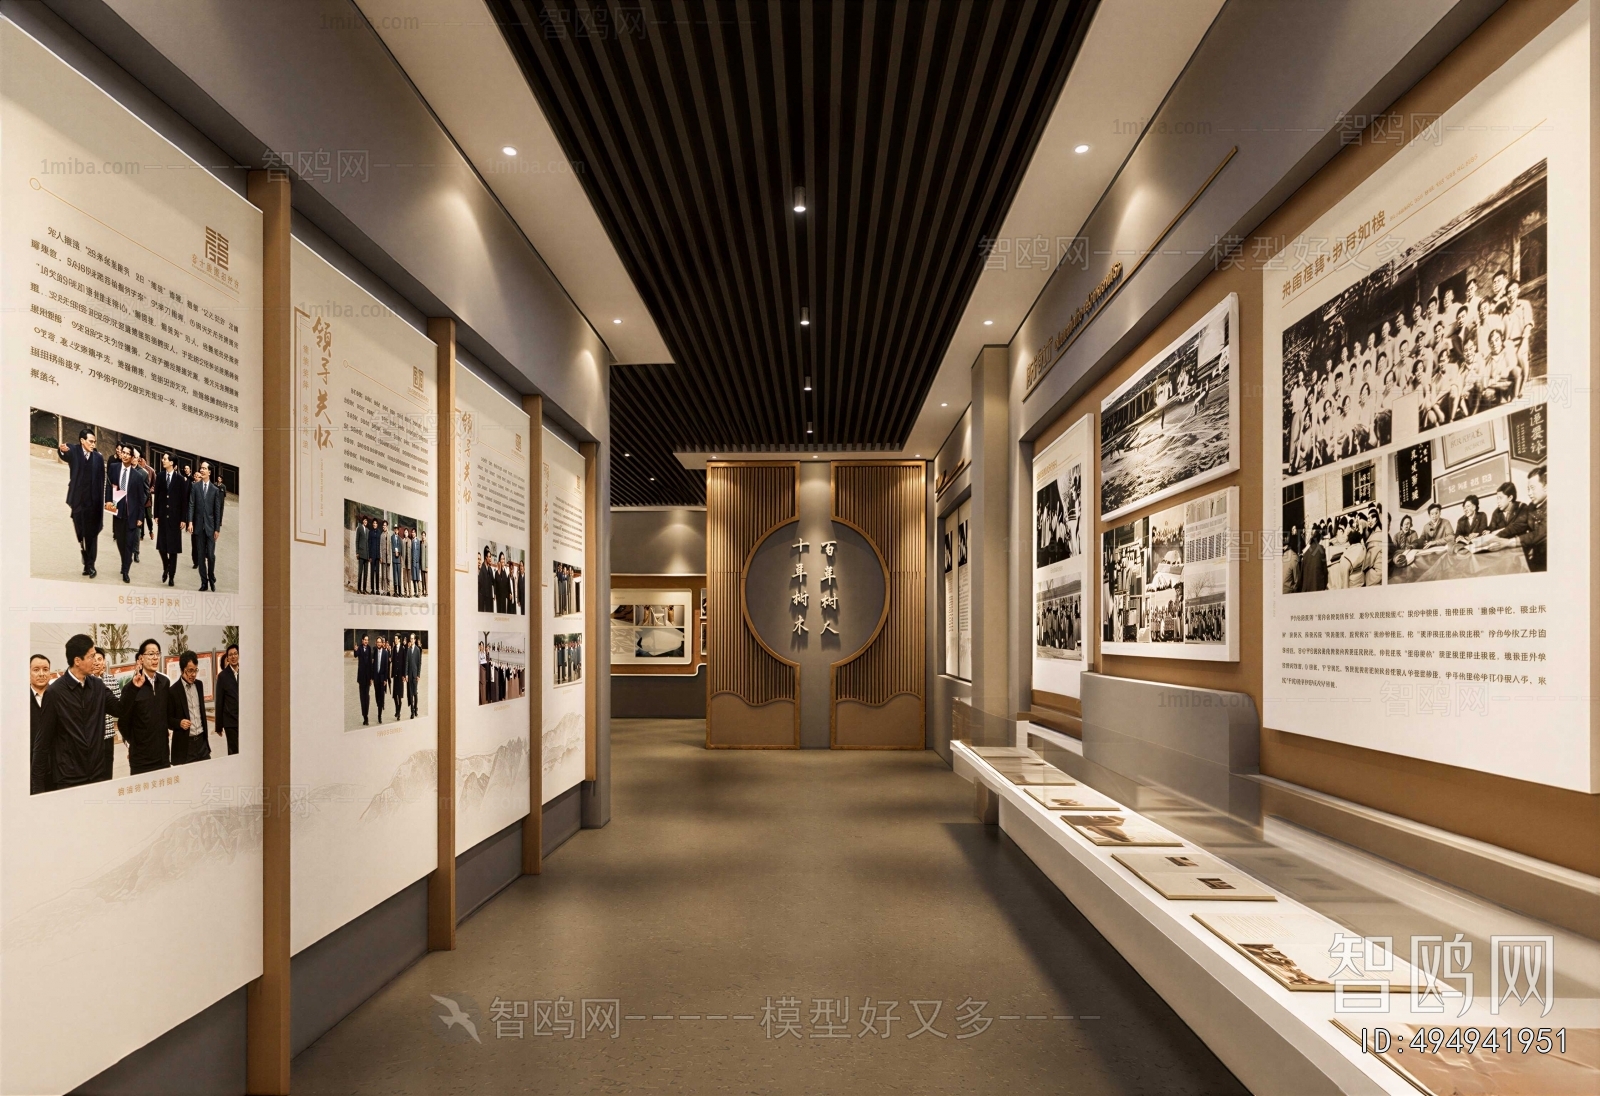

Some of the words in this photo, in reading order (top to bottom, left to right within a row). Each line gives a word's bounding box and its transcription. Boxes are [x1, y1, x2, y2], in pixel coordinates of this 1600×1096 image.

[792, 538, 810, 635] 十年树木
[820, 540, 839, 635] 百年树人
